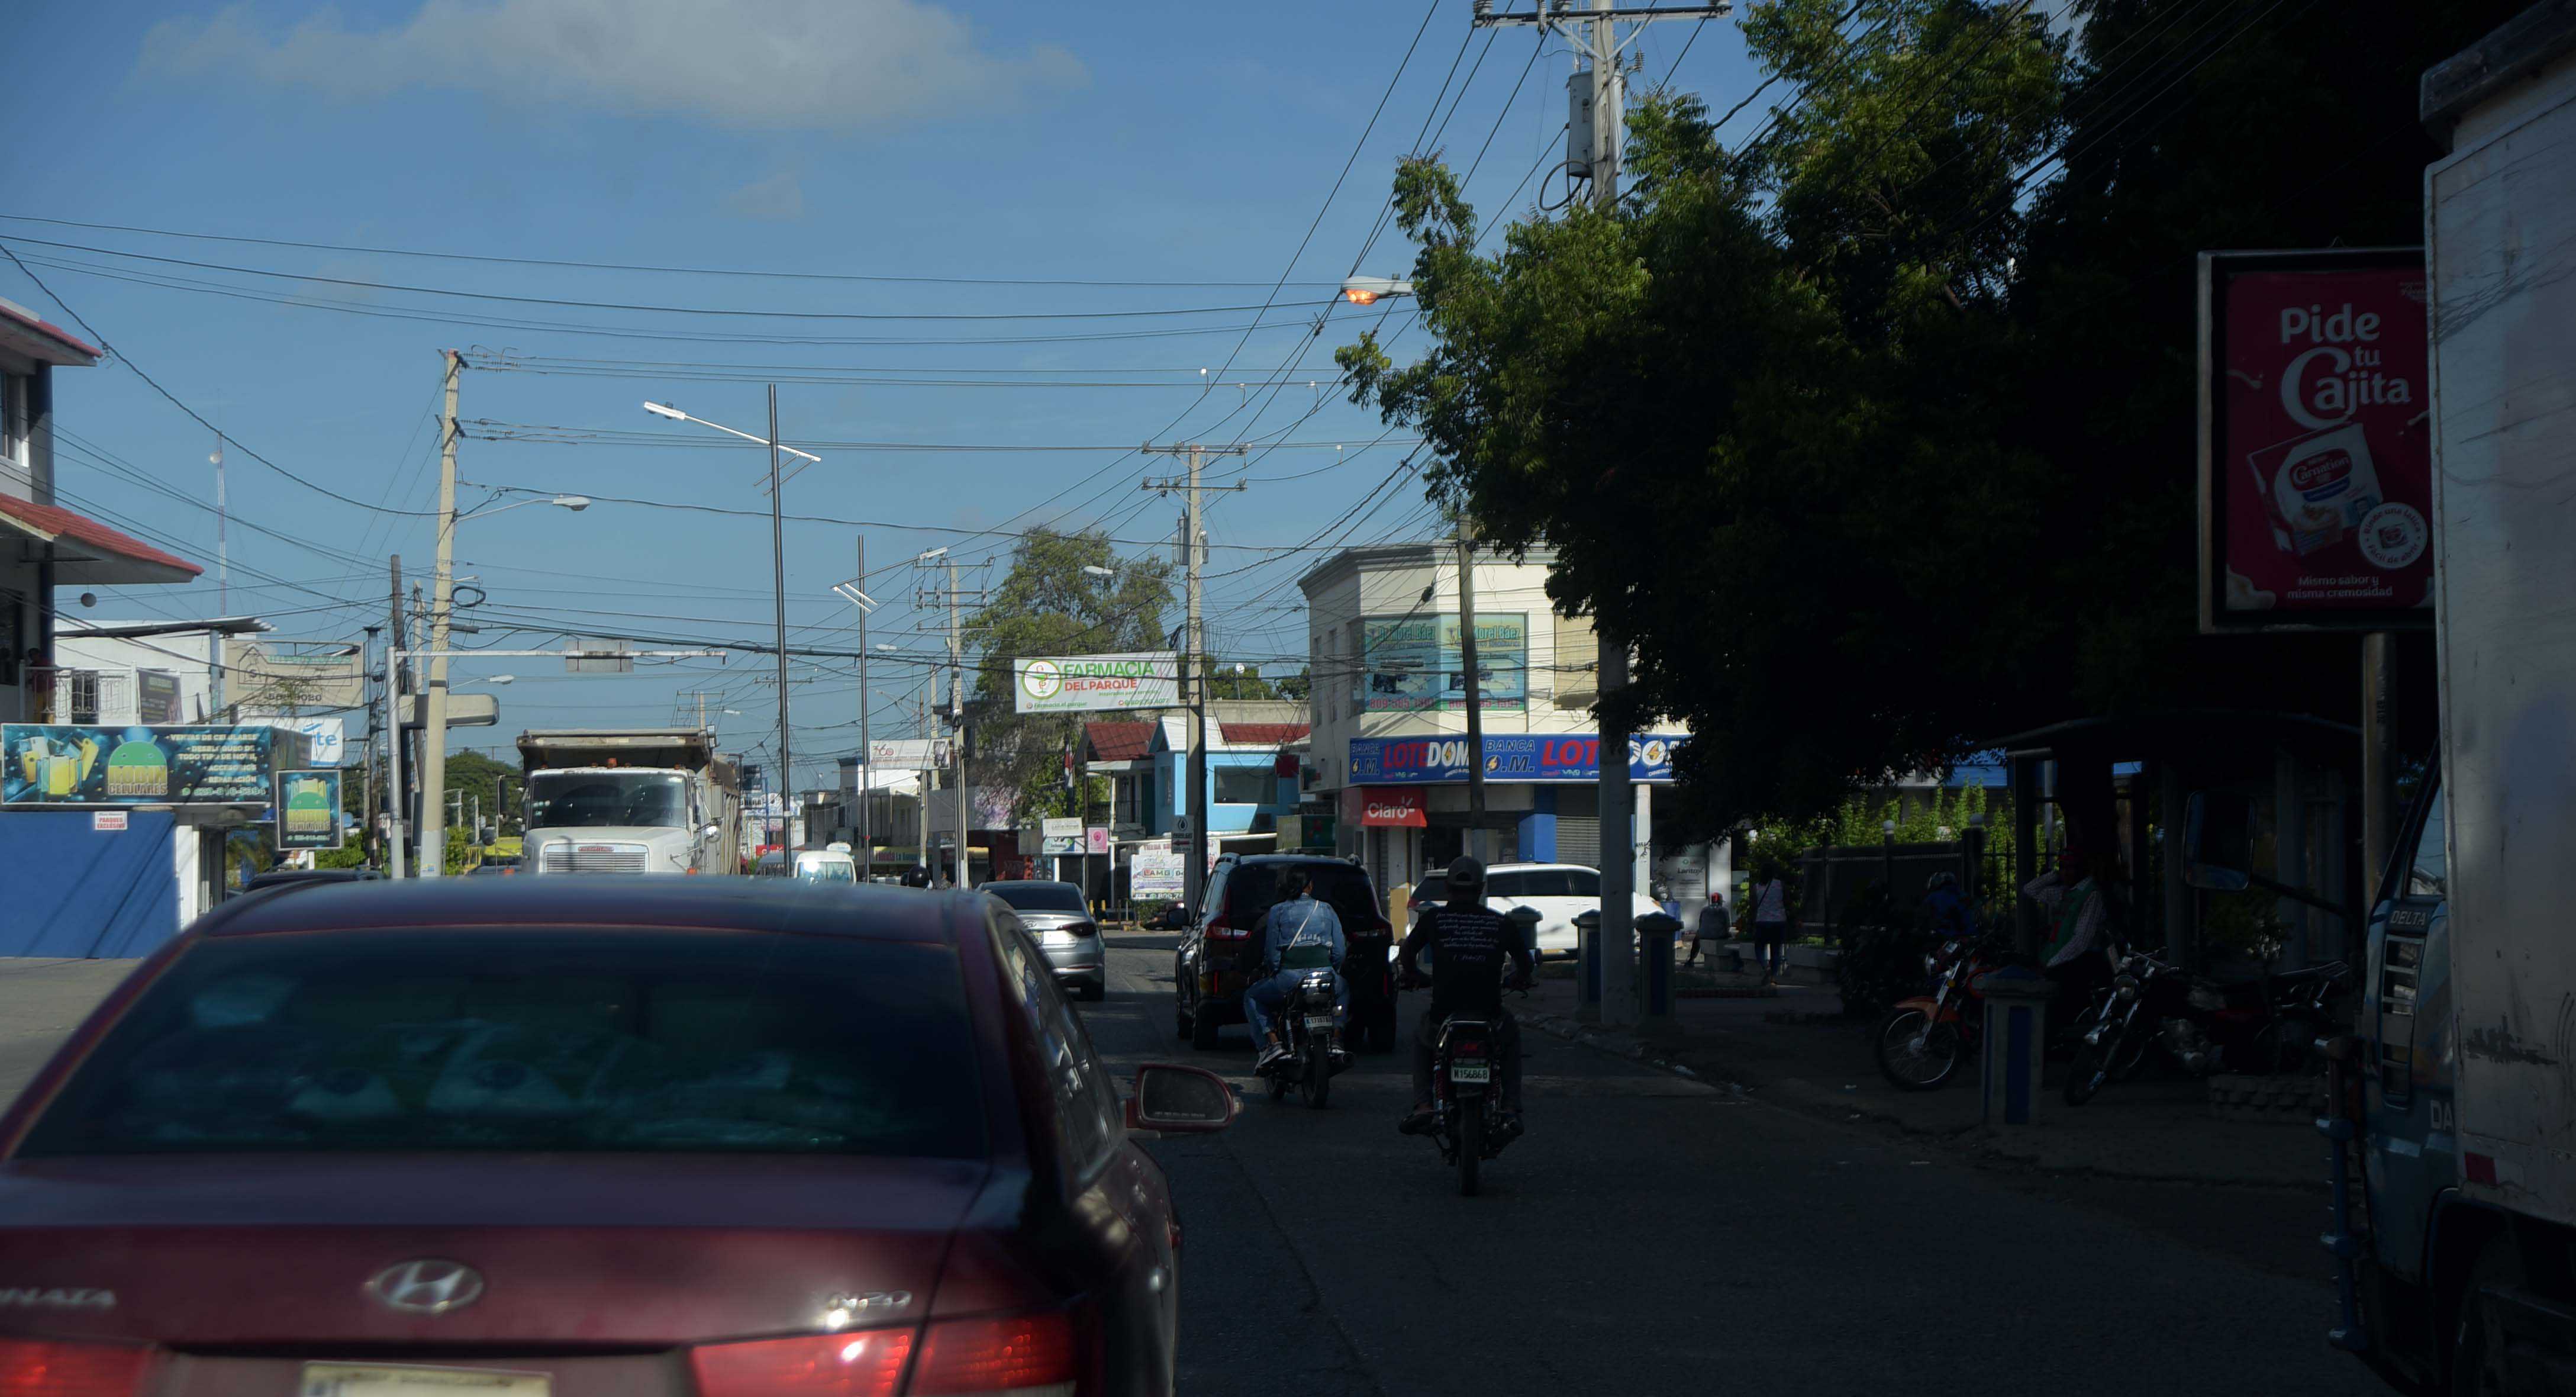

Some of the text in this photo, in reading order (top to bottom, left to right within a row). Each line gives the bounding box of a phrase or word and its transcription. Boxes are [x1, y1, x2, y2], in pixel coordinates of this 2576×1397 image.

[2281, 302, 2381, 345] Pide
[2355, 345, 2382, 366] tu
[2281, 346, 2413, 430] Cajita
[2293, 456, 2349, 484] Carnation
[2298, 575, 2380, 587] Mismo sabor y
[2287, 585, 2394, 600] misma cremosidad
[1416, 623, 1436, 639] Báez
[1498, 625, 1521, 640] Báez
[1063, 661, 1155, 678] FARMACIA
[1065, 678, 1137, 691] DEL PARQUE
[1351, 743, 1380, 754] BANCA
[1485, 740, 1536, 752] BANCA
[108, 783, 168, 796] CELULARES
[1368, 803, 1407, 818] Claro
[2390, 909, 2426, 926] DELTA
